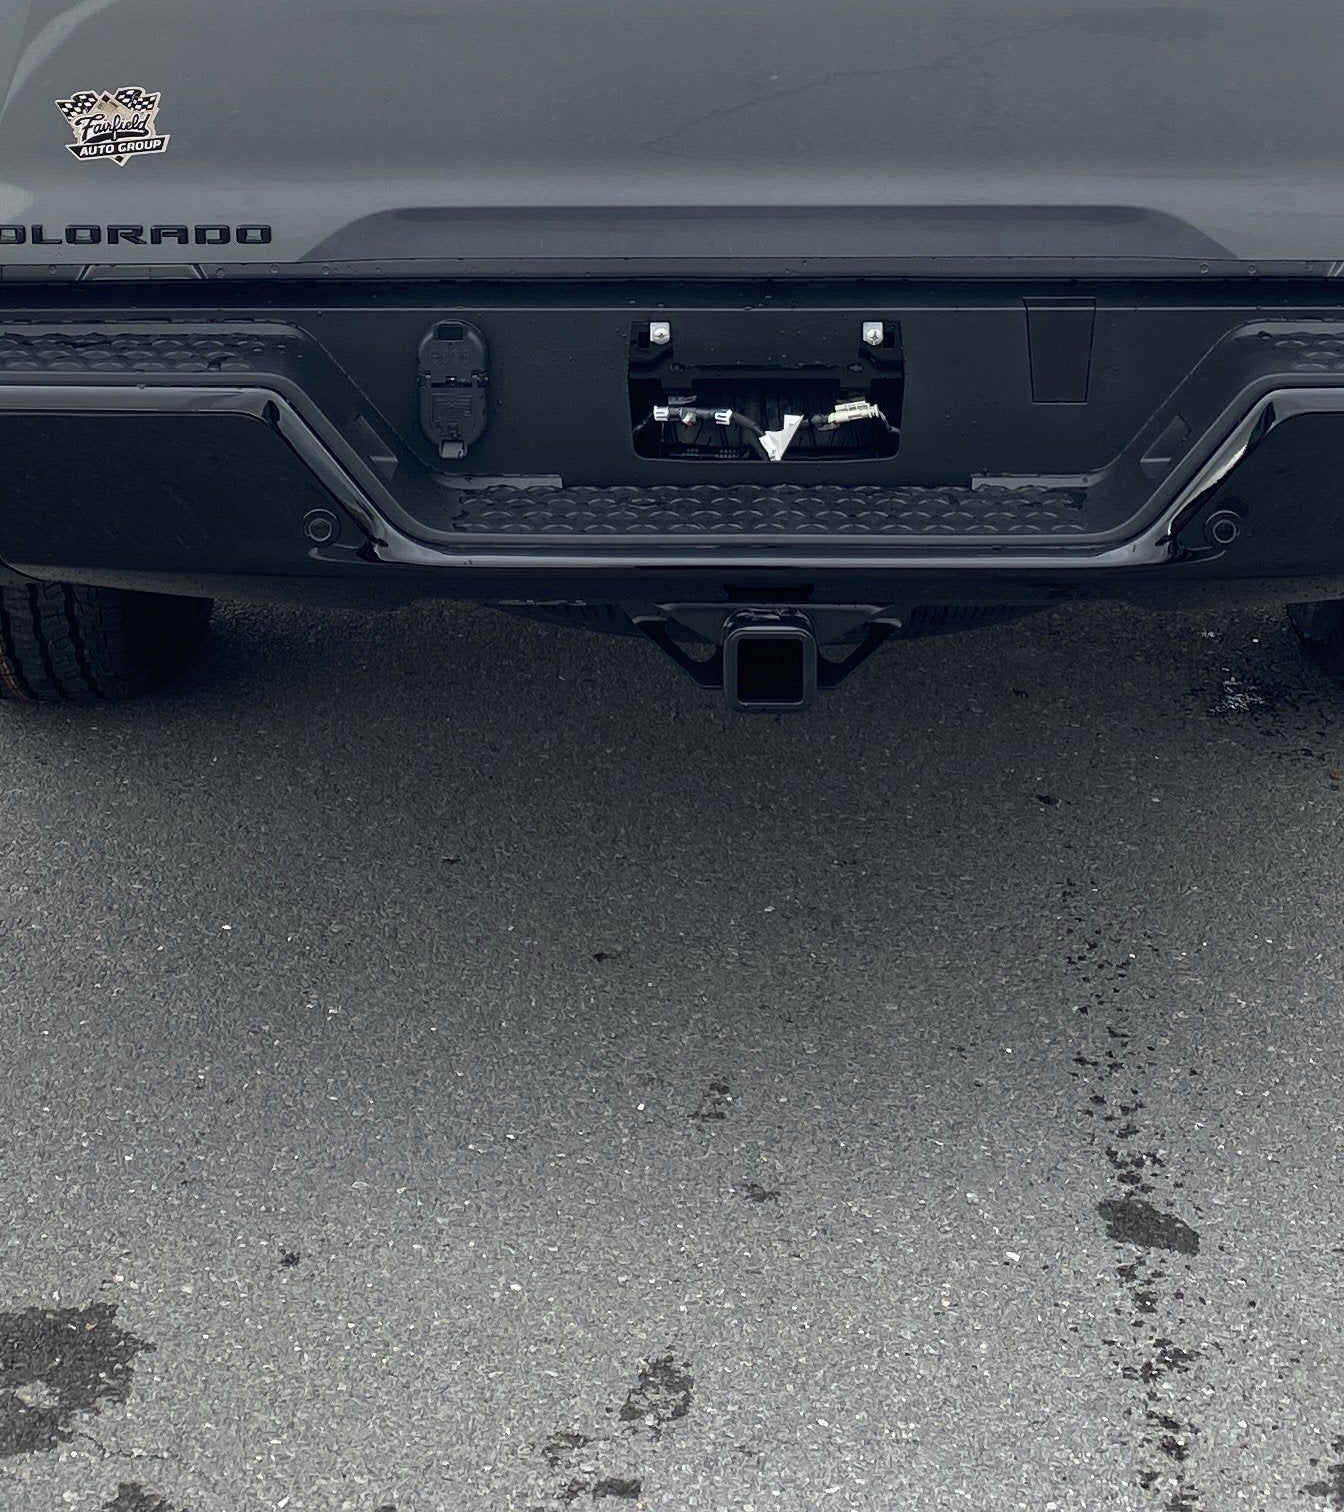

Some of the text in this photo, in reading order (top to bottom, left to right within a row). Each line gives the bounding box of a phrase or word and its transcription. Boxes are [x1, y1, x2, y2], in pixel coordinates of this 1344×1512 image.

[74, 113, 151, 143] Fairfield
[79, 139, 162, 157] AUTO GROUP
